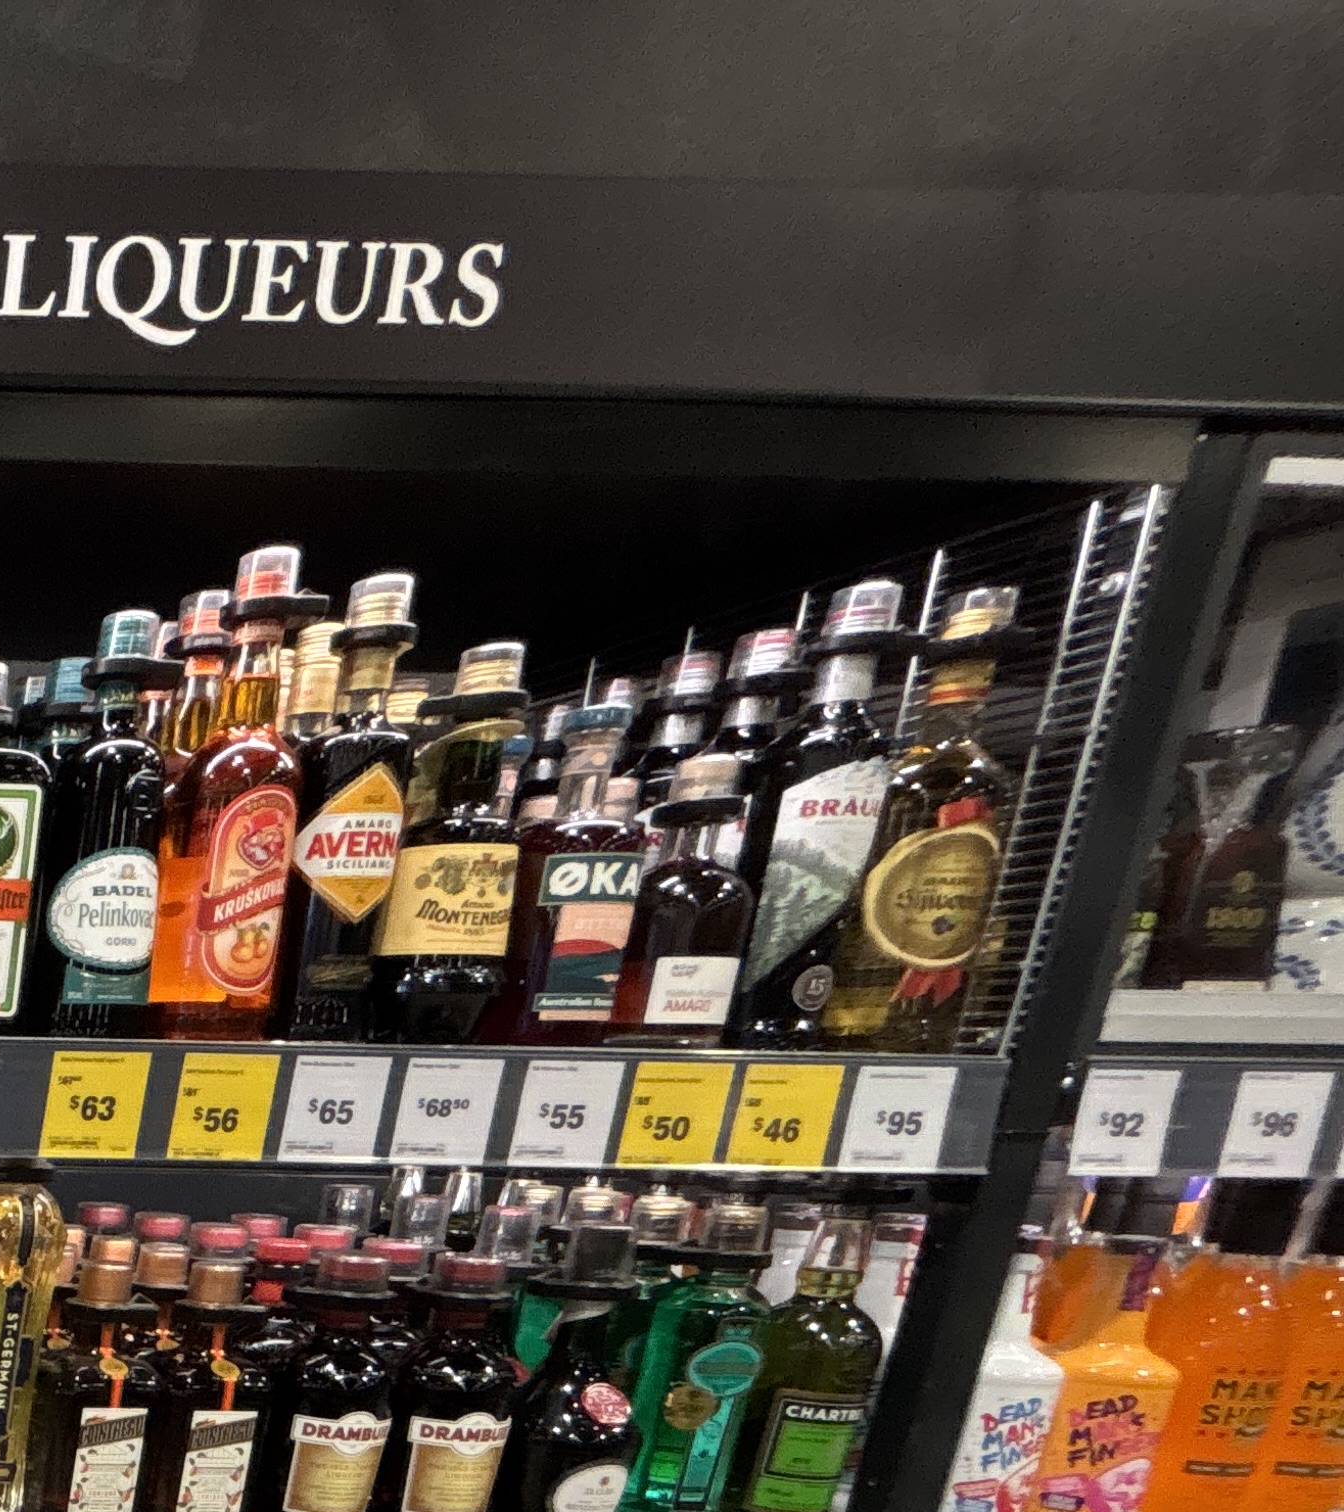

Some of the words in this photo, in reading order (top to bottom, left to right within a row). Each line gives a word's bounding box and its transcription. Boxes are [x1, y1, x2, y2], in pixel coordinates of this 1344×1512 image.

[344, 820, 393, 830] AMARO
[92, 885, 153, 898] BADEL
[70, 1096, 116, 1121] $63
[193, 1107, 239, 1132] $56
[308, 1099, 354, 1124] $65
[539, 1103, 586, 1129] $55
[643, 1115, 690, 1141] $50
[754, 1117, 801, 1143] $46
[877, 1111, 923, 1135] $95
